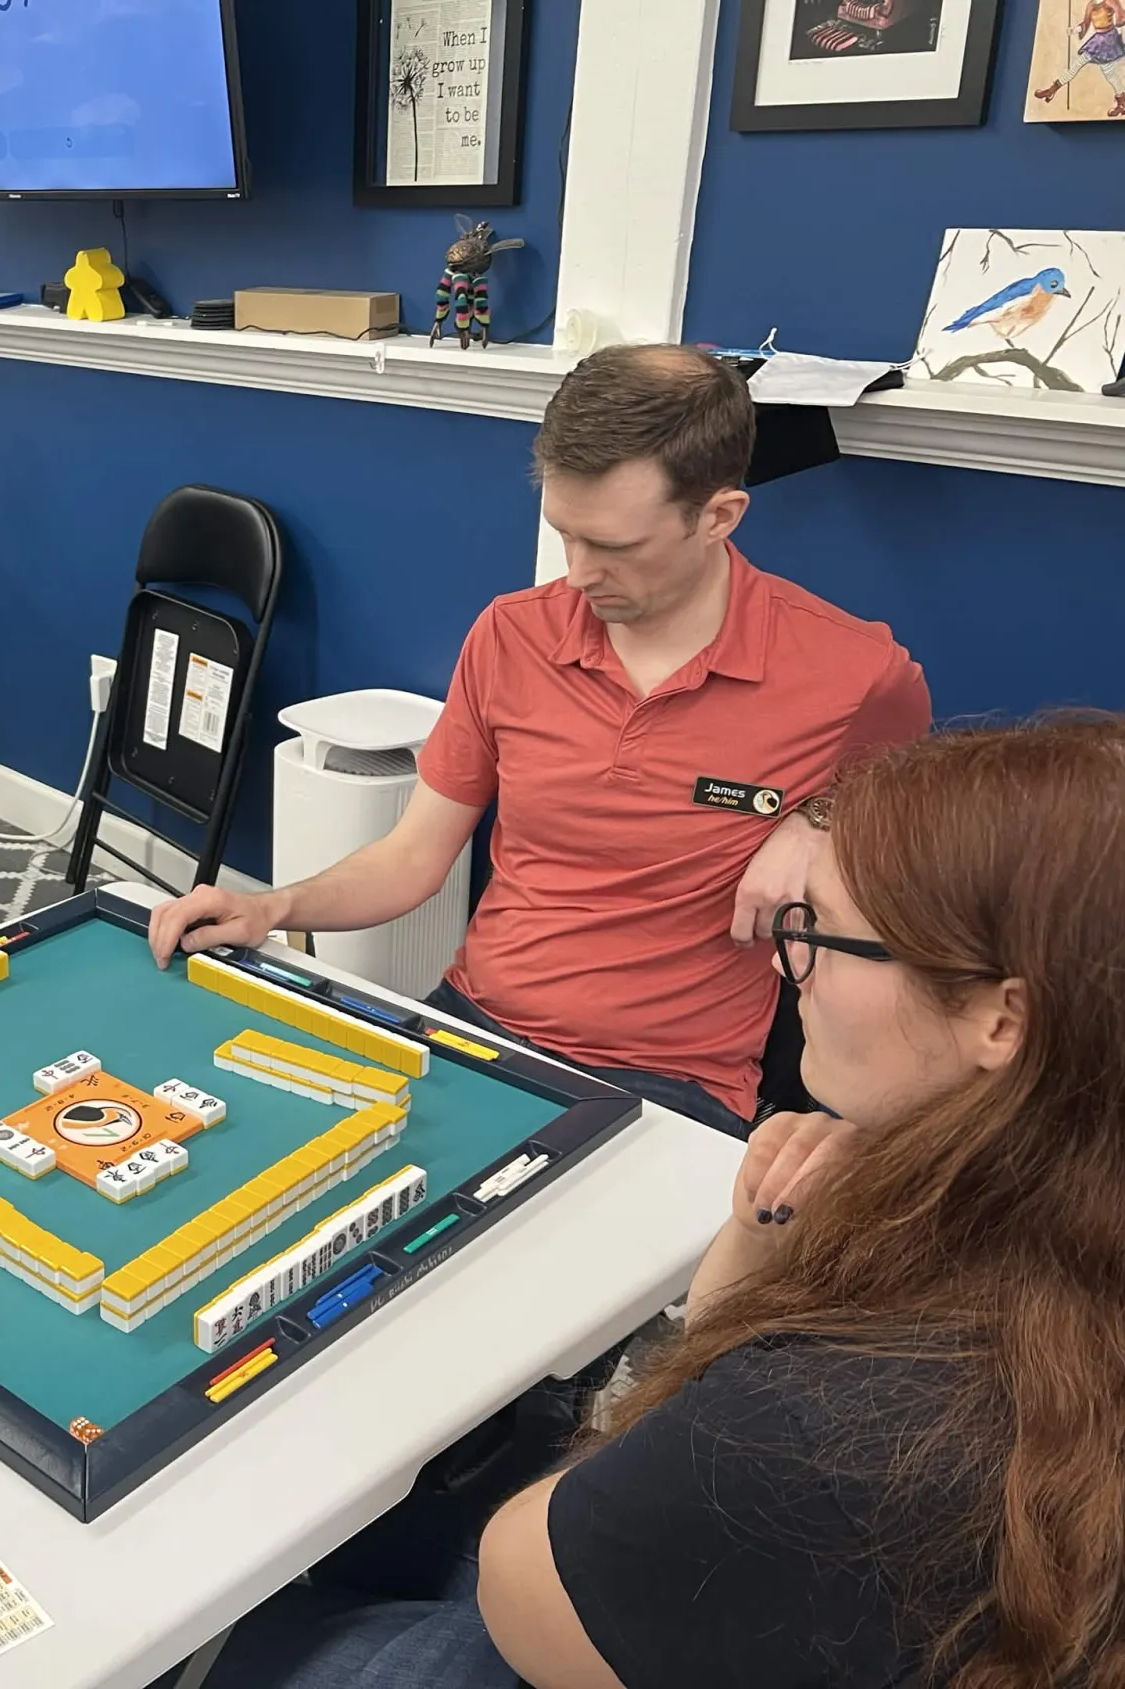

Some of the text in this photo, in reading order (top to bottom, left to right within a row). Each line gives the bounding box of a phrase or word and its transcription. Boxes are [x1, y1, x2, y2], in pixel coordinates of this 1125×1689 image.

[442, 27, 488, 47] When I
[432, 58, 486, 77] grow up
[437, 82, 480, 98] I want
[445, 106, 479, 122] to be
[461, 133, 482, 147] me.
[704, 783, 746, 799] James
